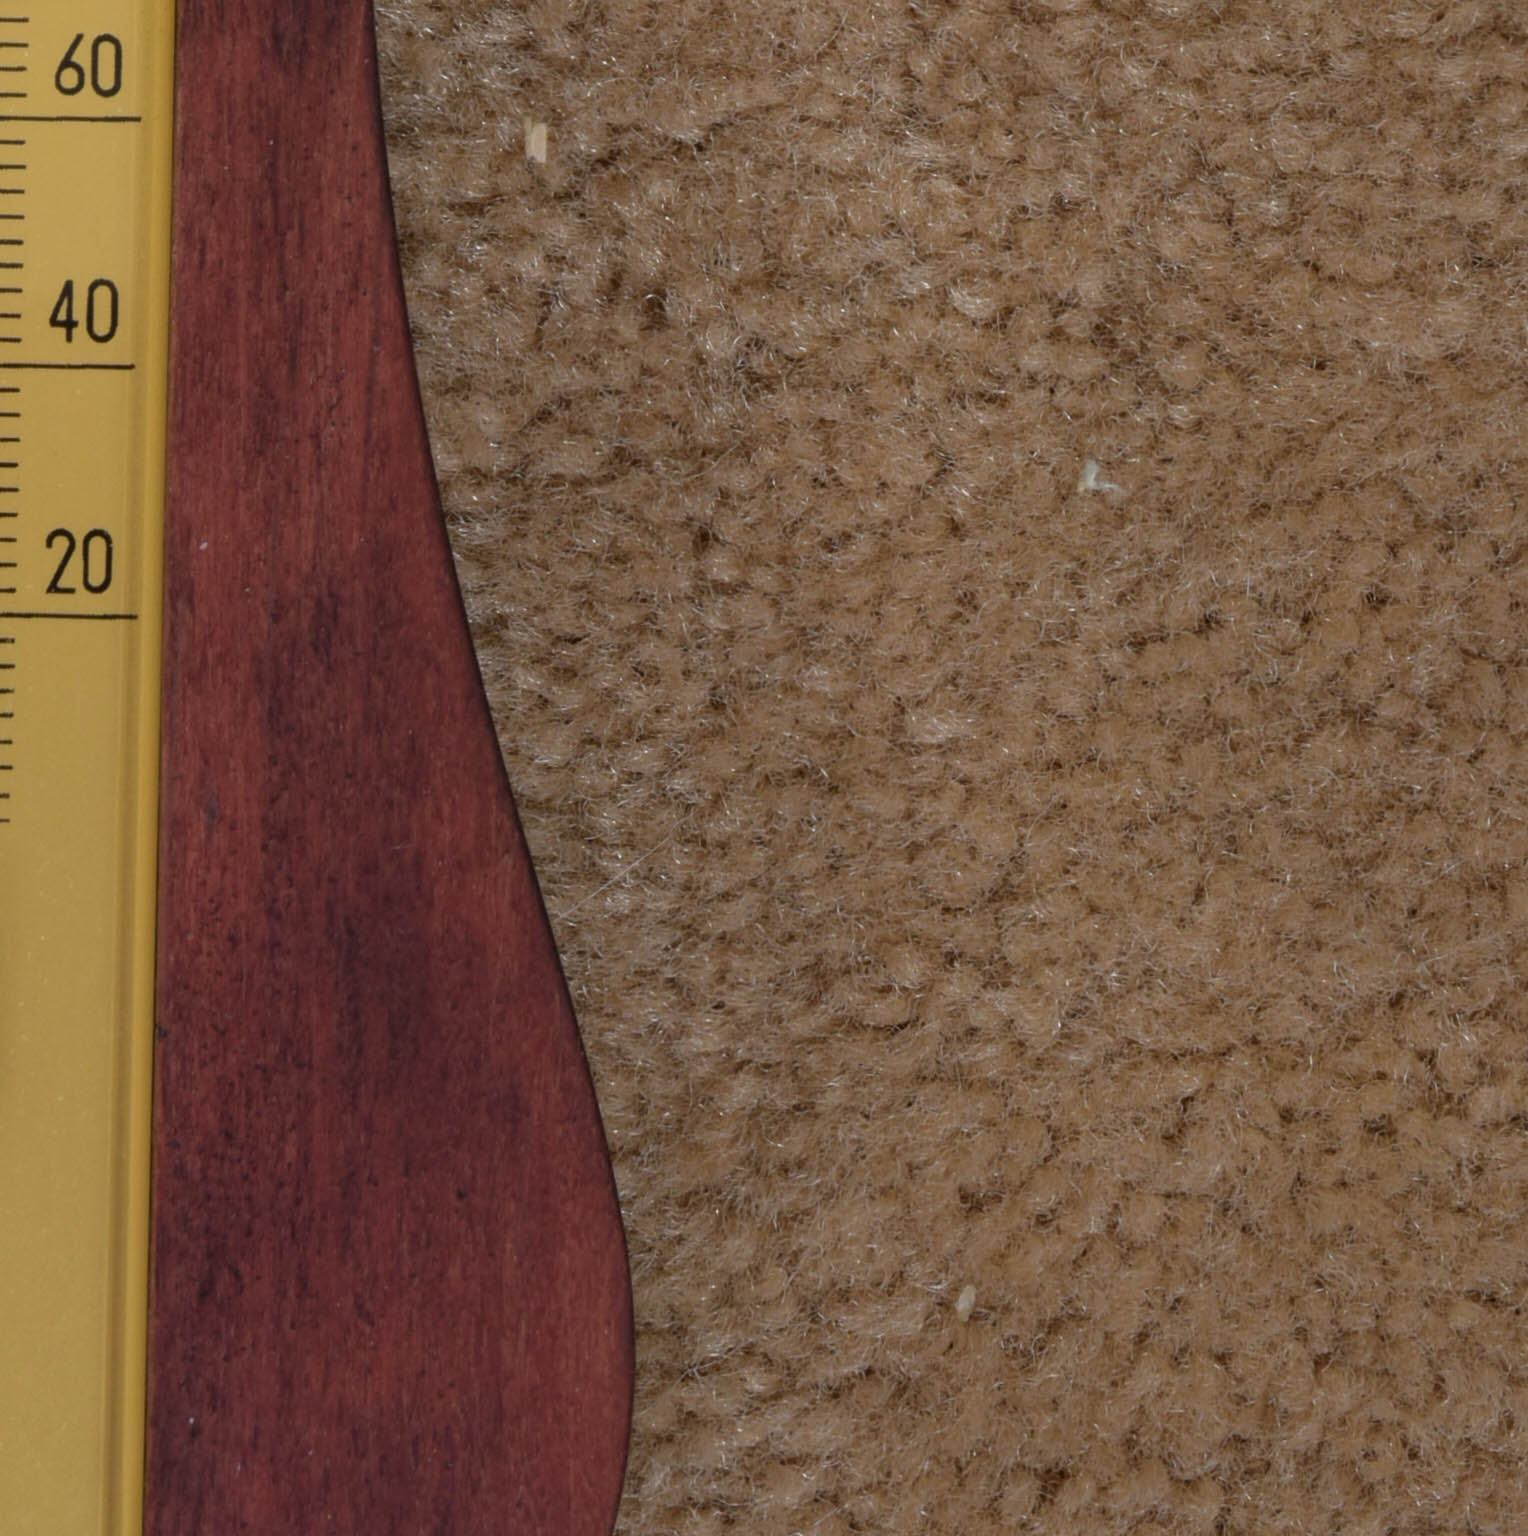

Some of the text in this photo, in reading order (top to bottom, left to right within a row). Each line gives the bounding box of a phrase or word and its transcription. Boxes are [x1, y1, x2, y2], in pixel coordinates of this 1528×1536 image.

[55, 34, 122, 98] 60
[49, 279, 118, 343] 40
[46, 528, 113, 594] 20
